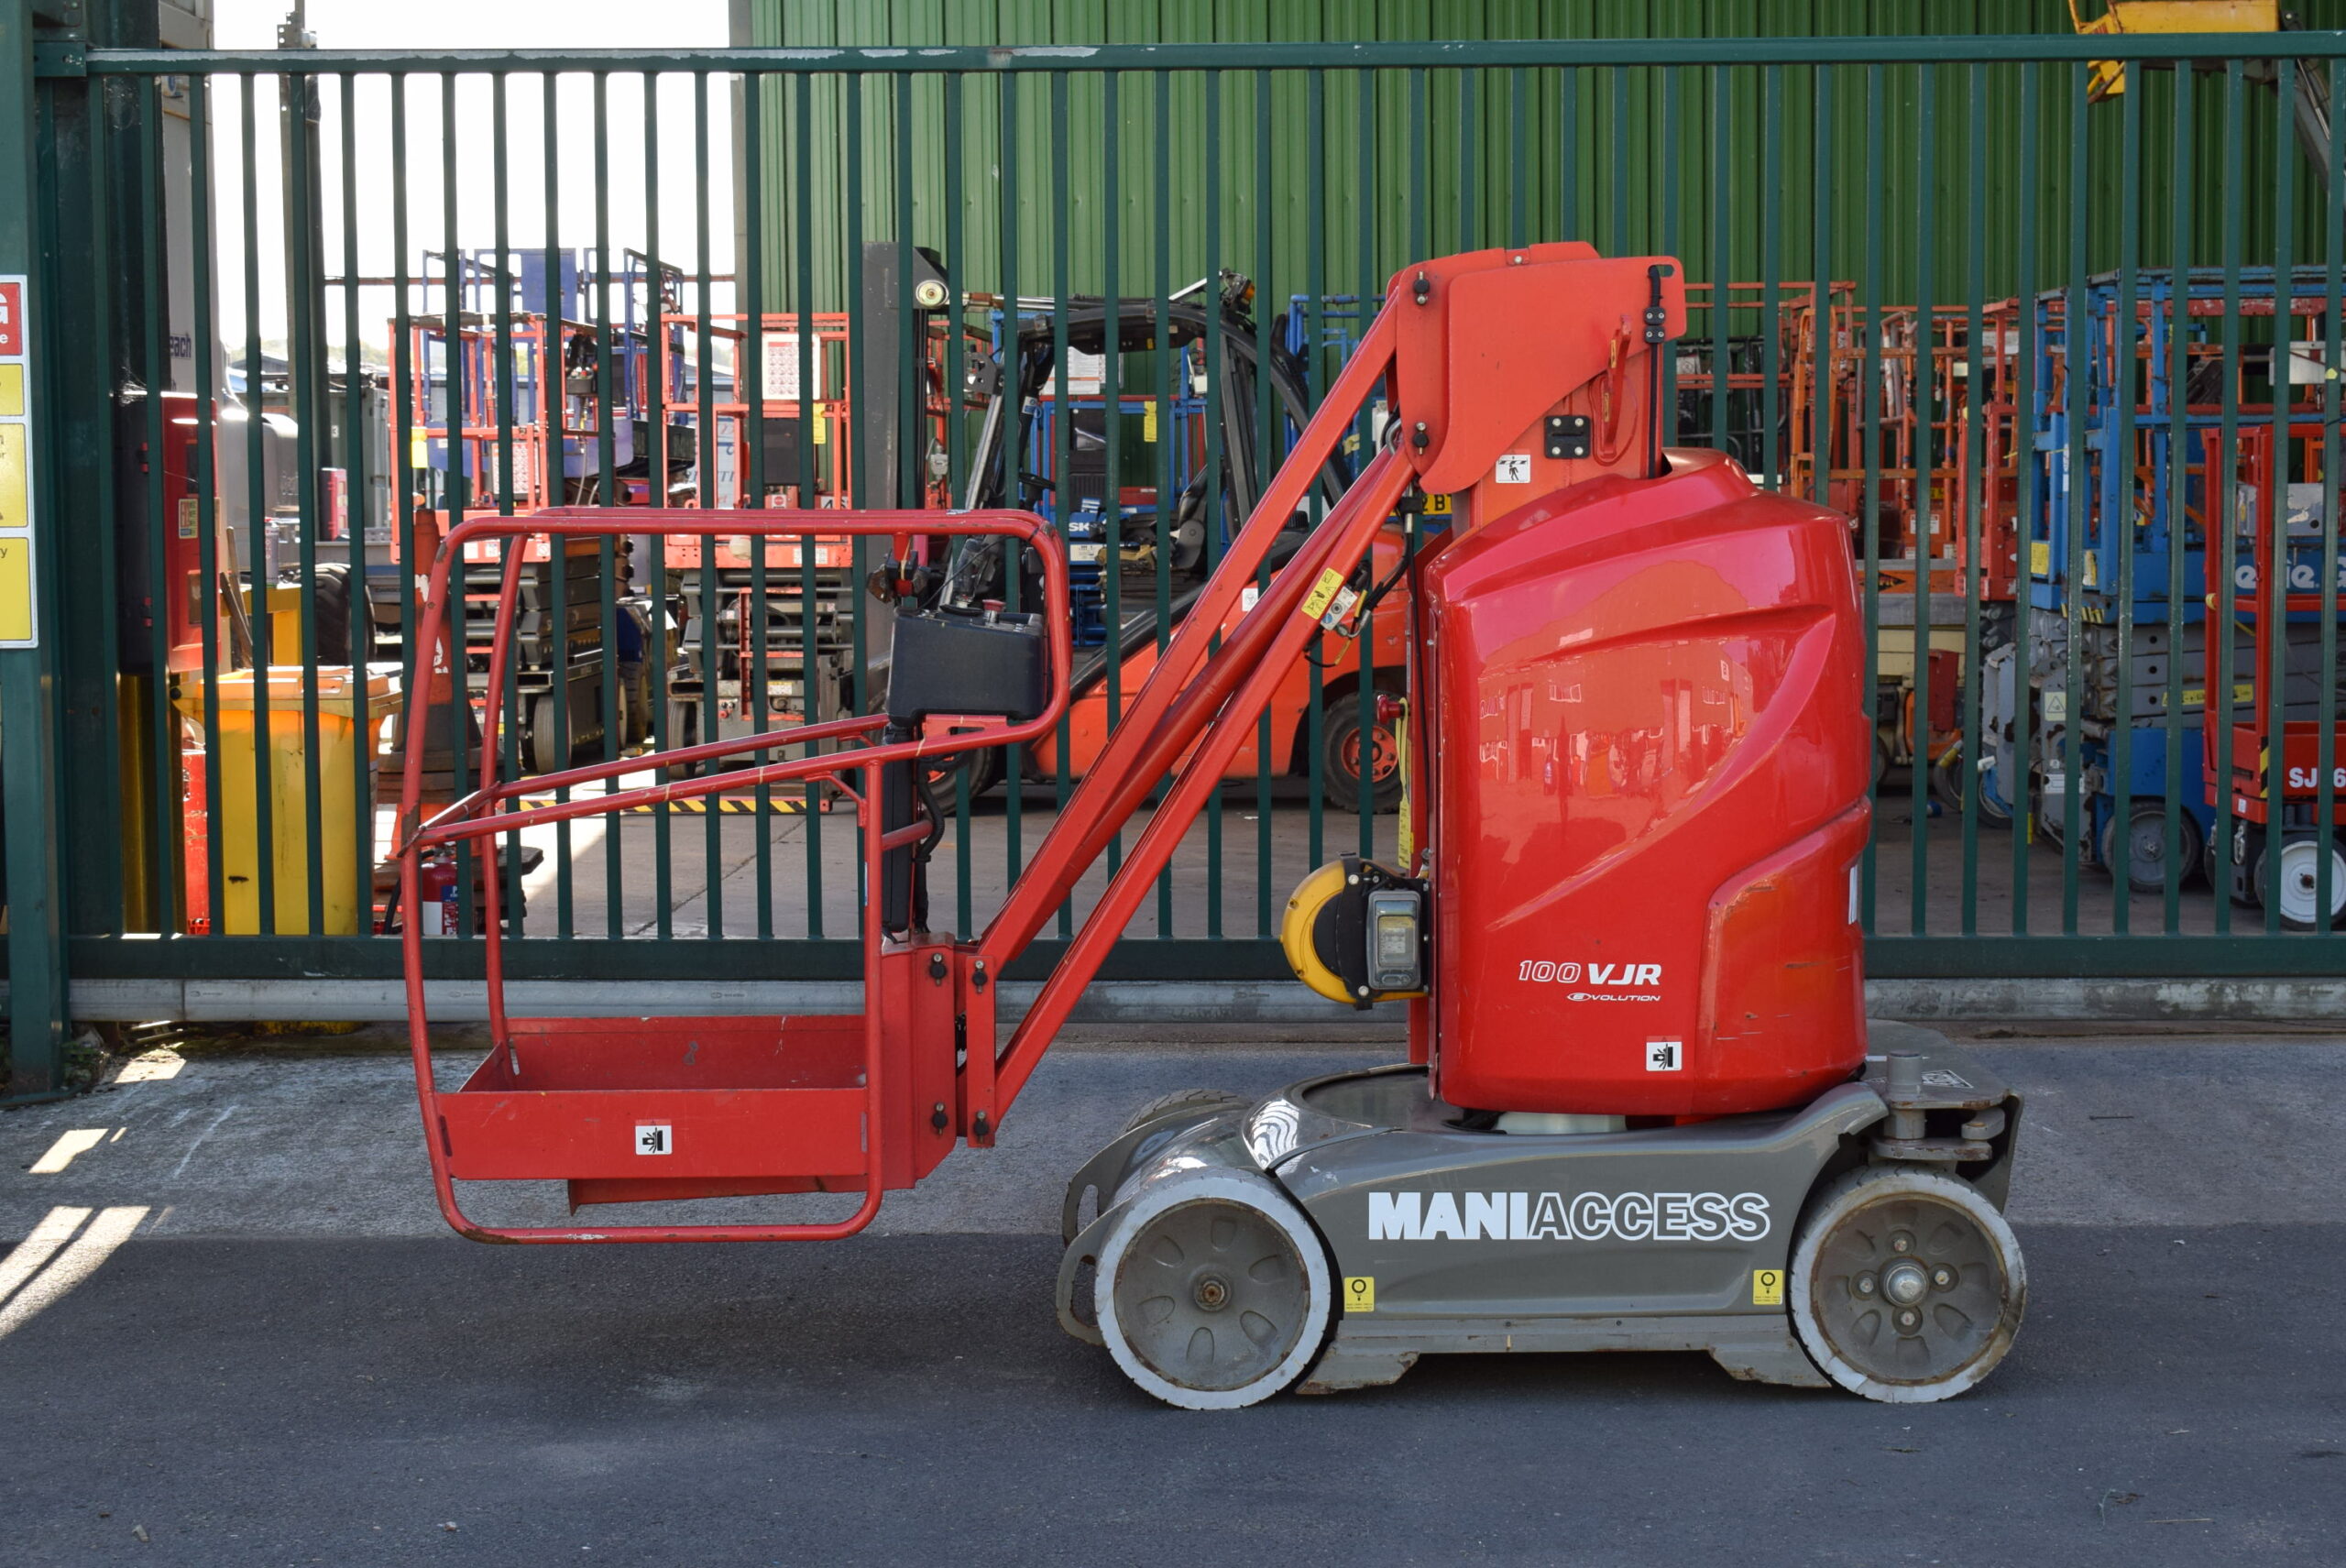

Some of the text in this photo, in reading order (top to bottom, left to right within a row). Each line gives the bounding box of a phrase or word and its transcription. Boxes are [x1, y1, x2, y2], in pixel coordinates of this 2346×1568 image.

[1518, 960, 1662, 985] 100 VJR
[1567, 992, 1661, 1002] EVOLUTION
[1369, 1192, 1770, 1241] MANIACCESS
